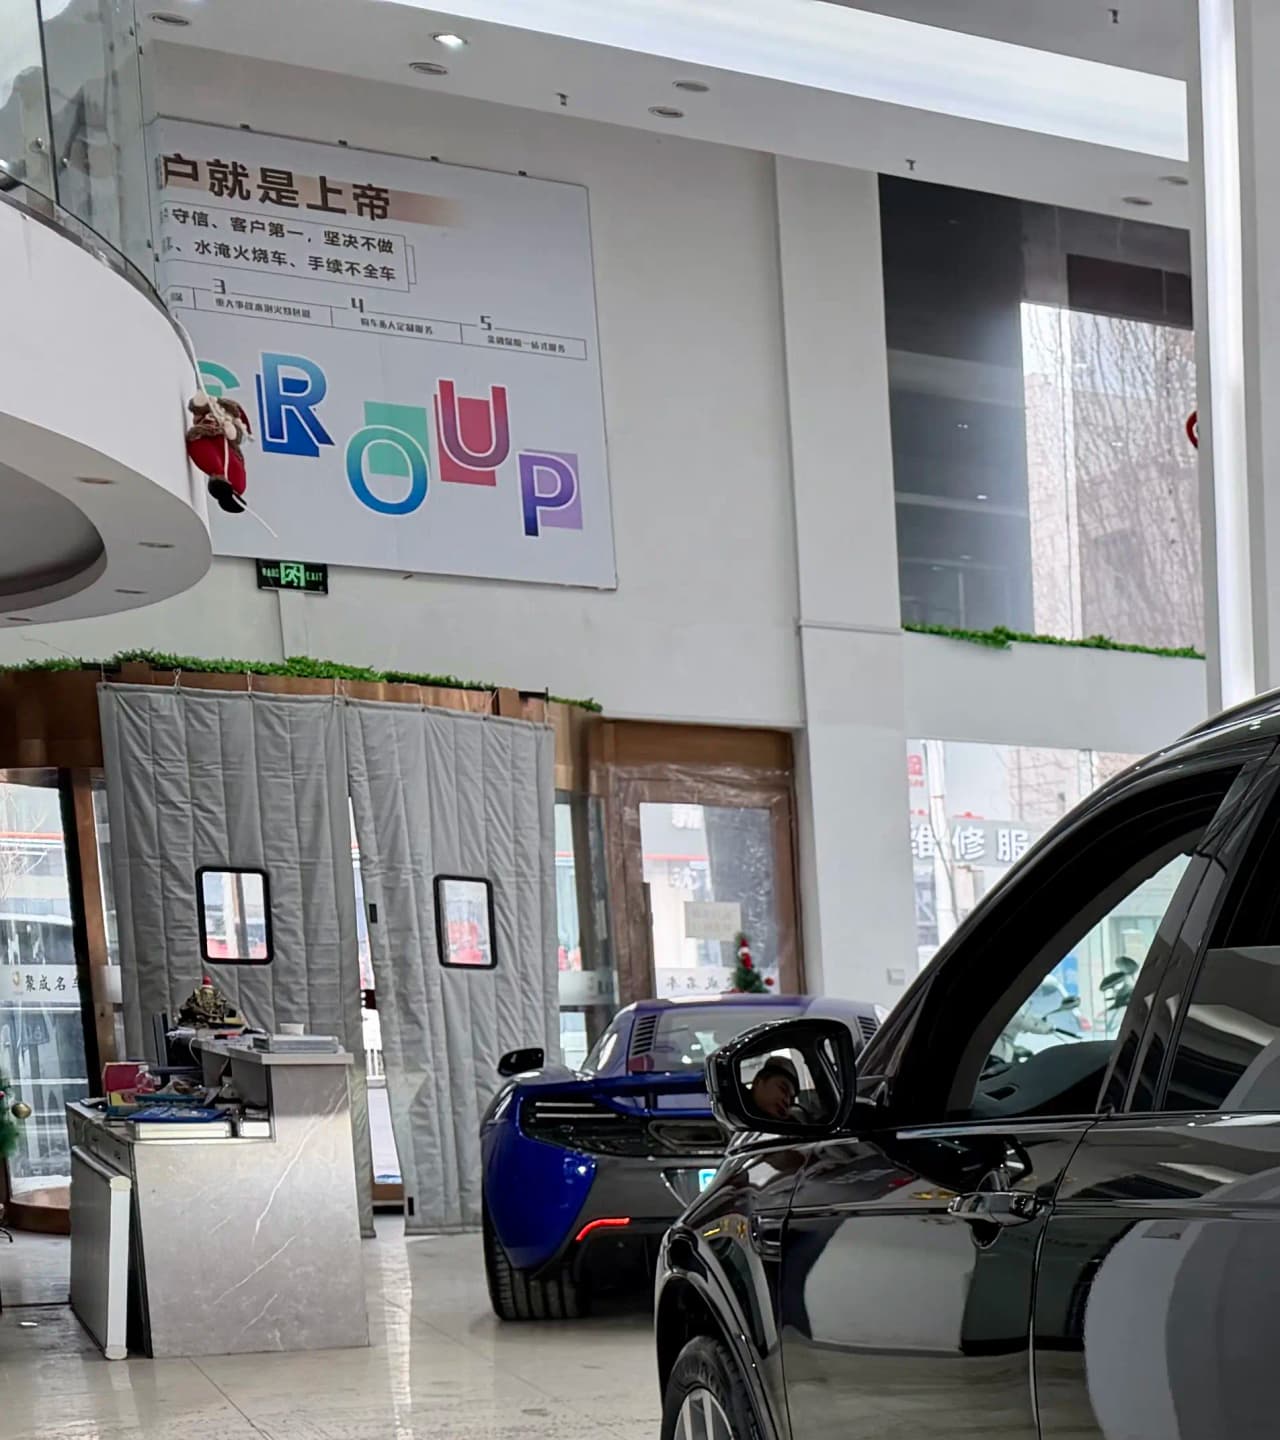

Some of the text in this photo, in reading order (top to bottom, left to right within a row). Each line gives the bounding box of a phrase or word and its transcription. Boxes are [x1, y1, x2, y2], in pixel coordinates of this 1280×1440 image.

[161, 207, 394, 254] 守信、客户第一，坚决不做
